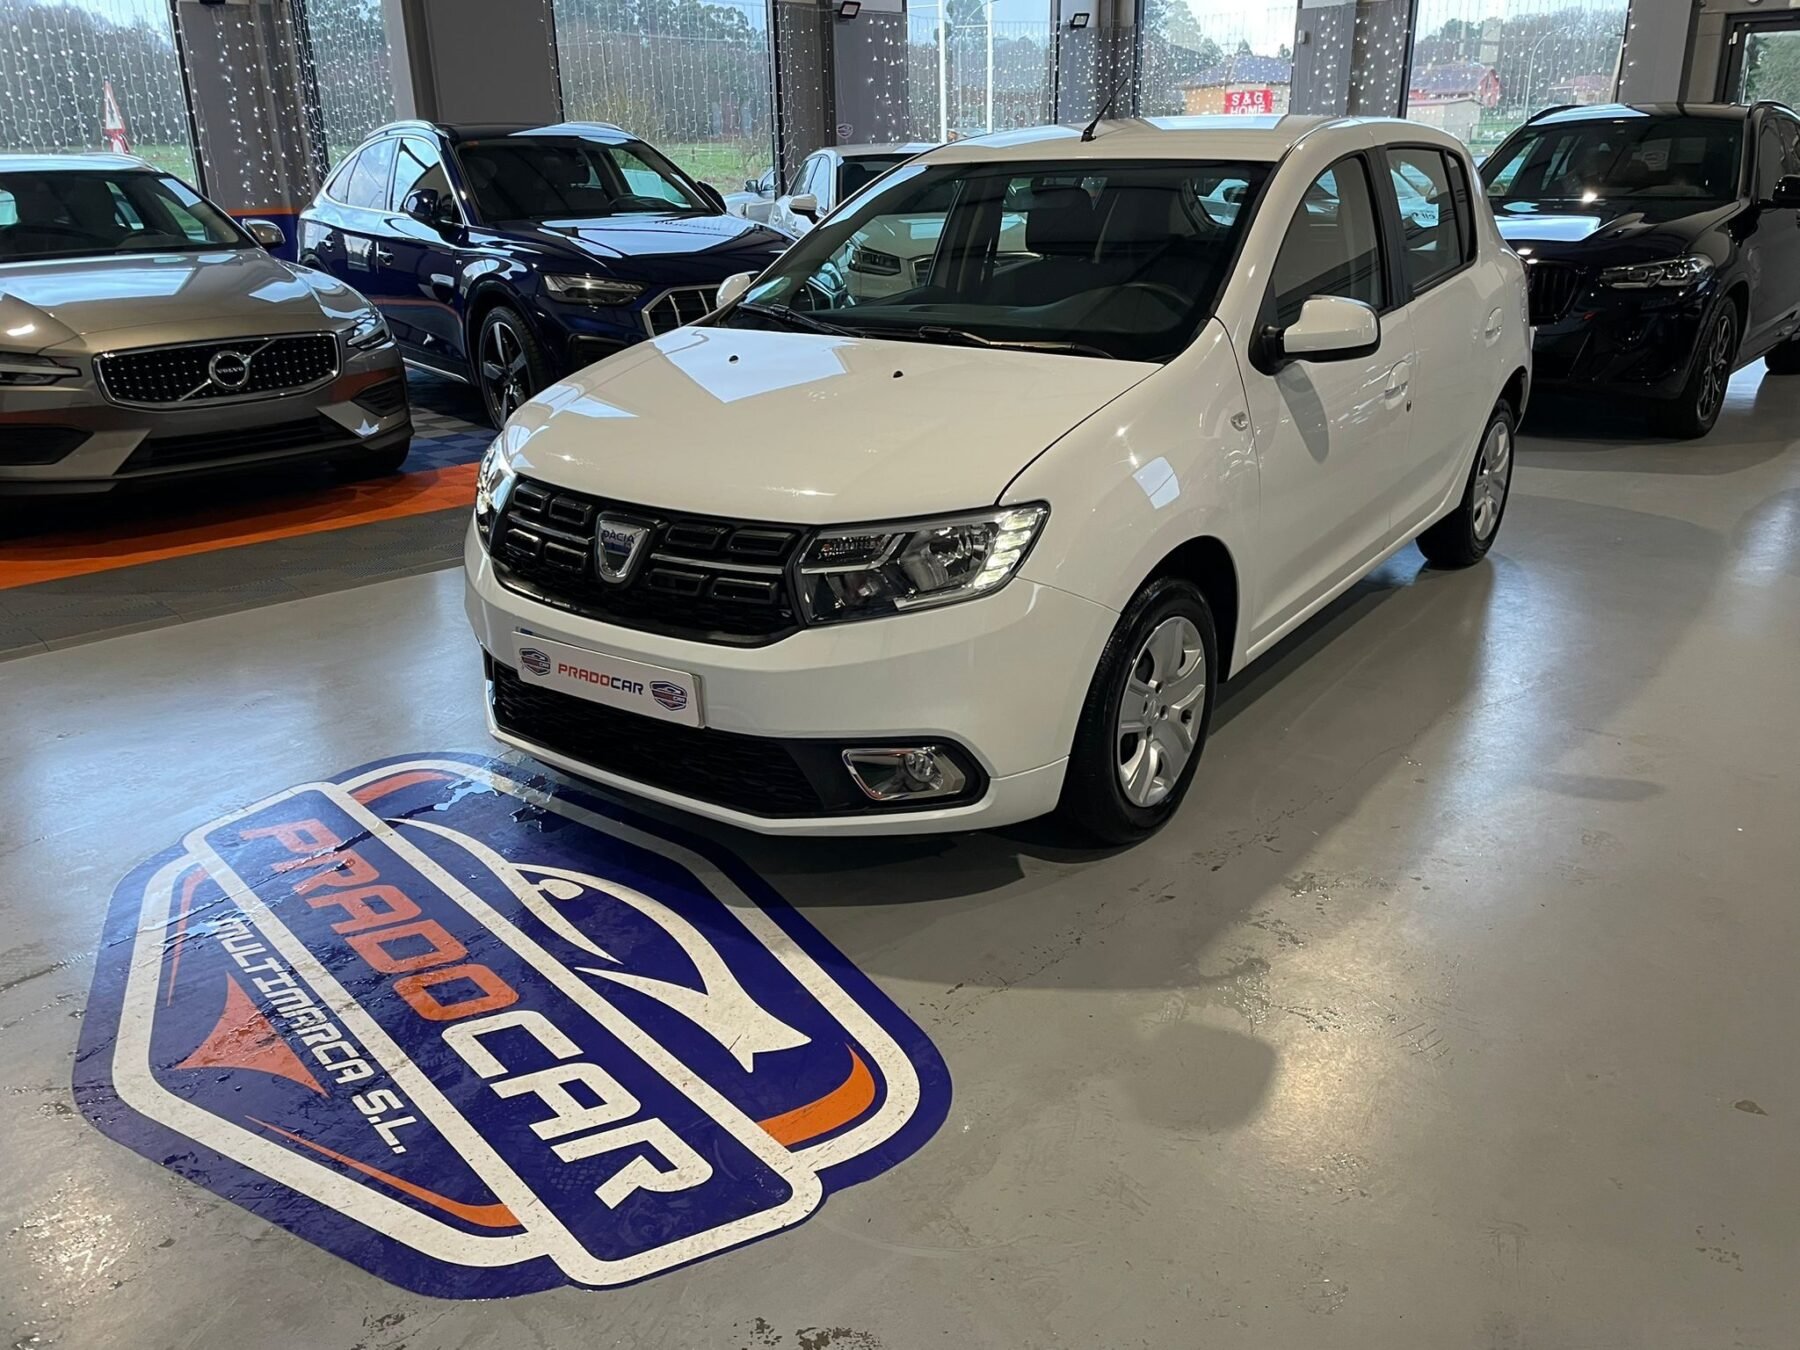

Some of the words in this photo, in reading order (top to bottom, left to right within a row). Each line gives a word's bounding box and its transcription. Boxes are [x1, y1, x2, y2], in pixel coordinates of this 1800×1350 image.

[1231, 93, 1241, 105] S
[1243, 92, 1251, 105] &
[602, 530, 634, 544] DACIA
[557, 663, 644, 696] PRADOCAR
[240, 818, 713, 1209] PRADOCAR
[215, 917, 375, 1084] MULTIMARCA
[352, 1089, 417, 1154] S.L.
